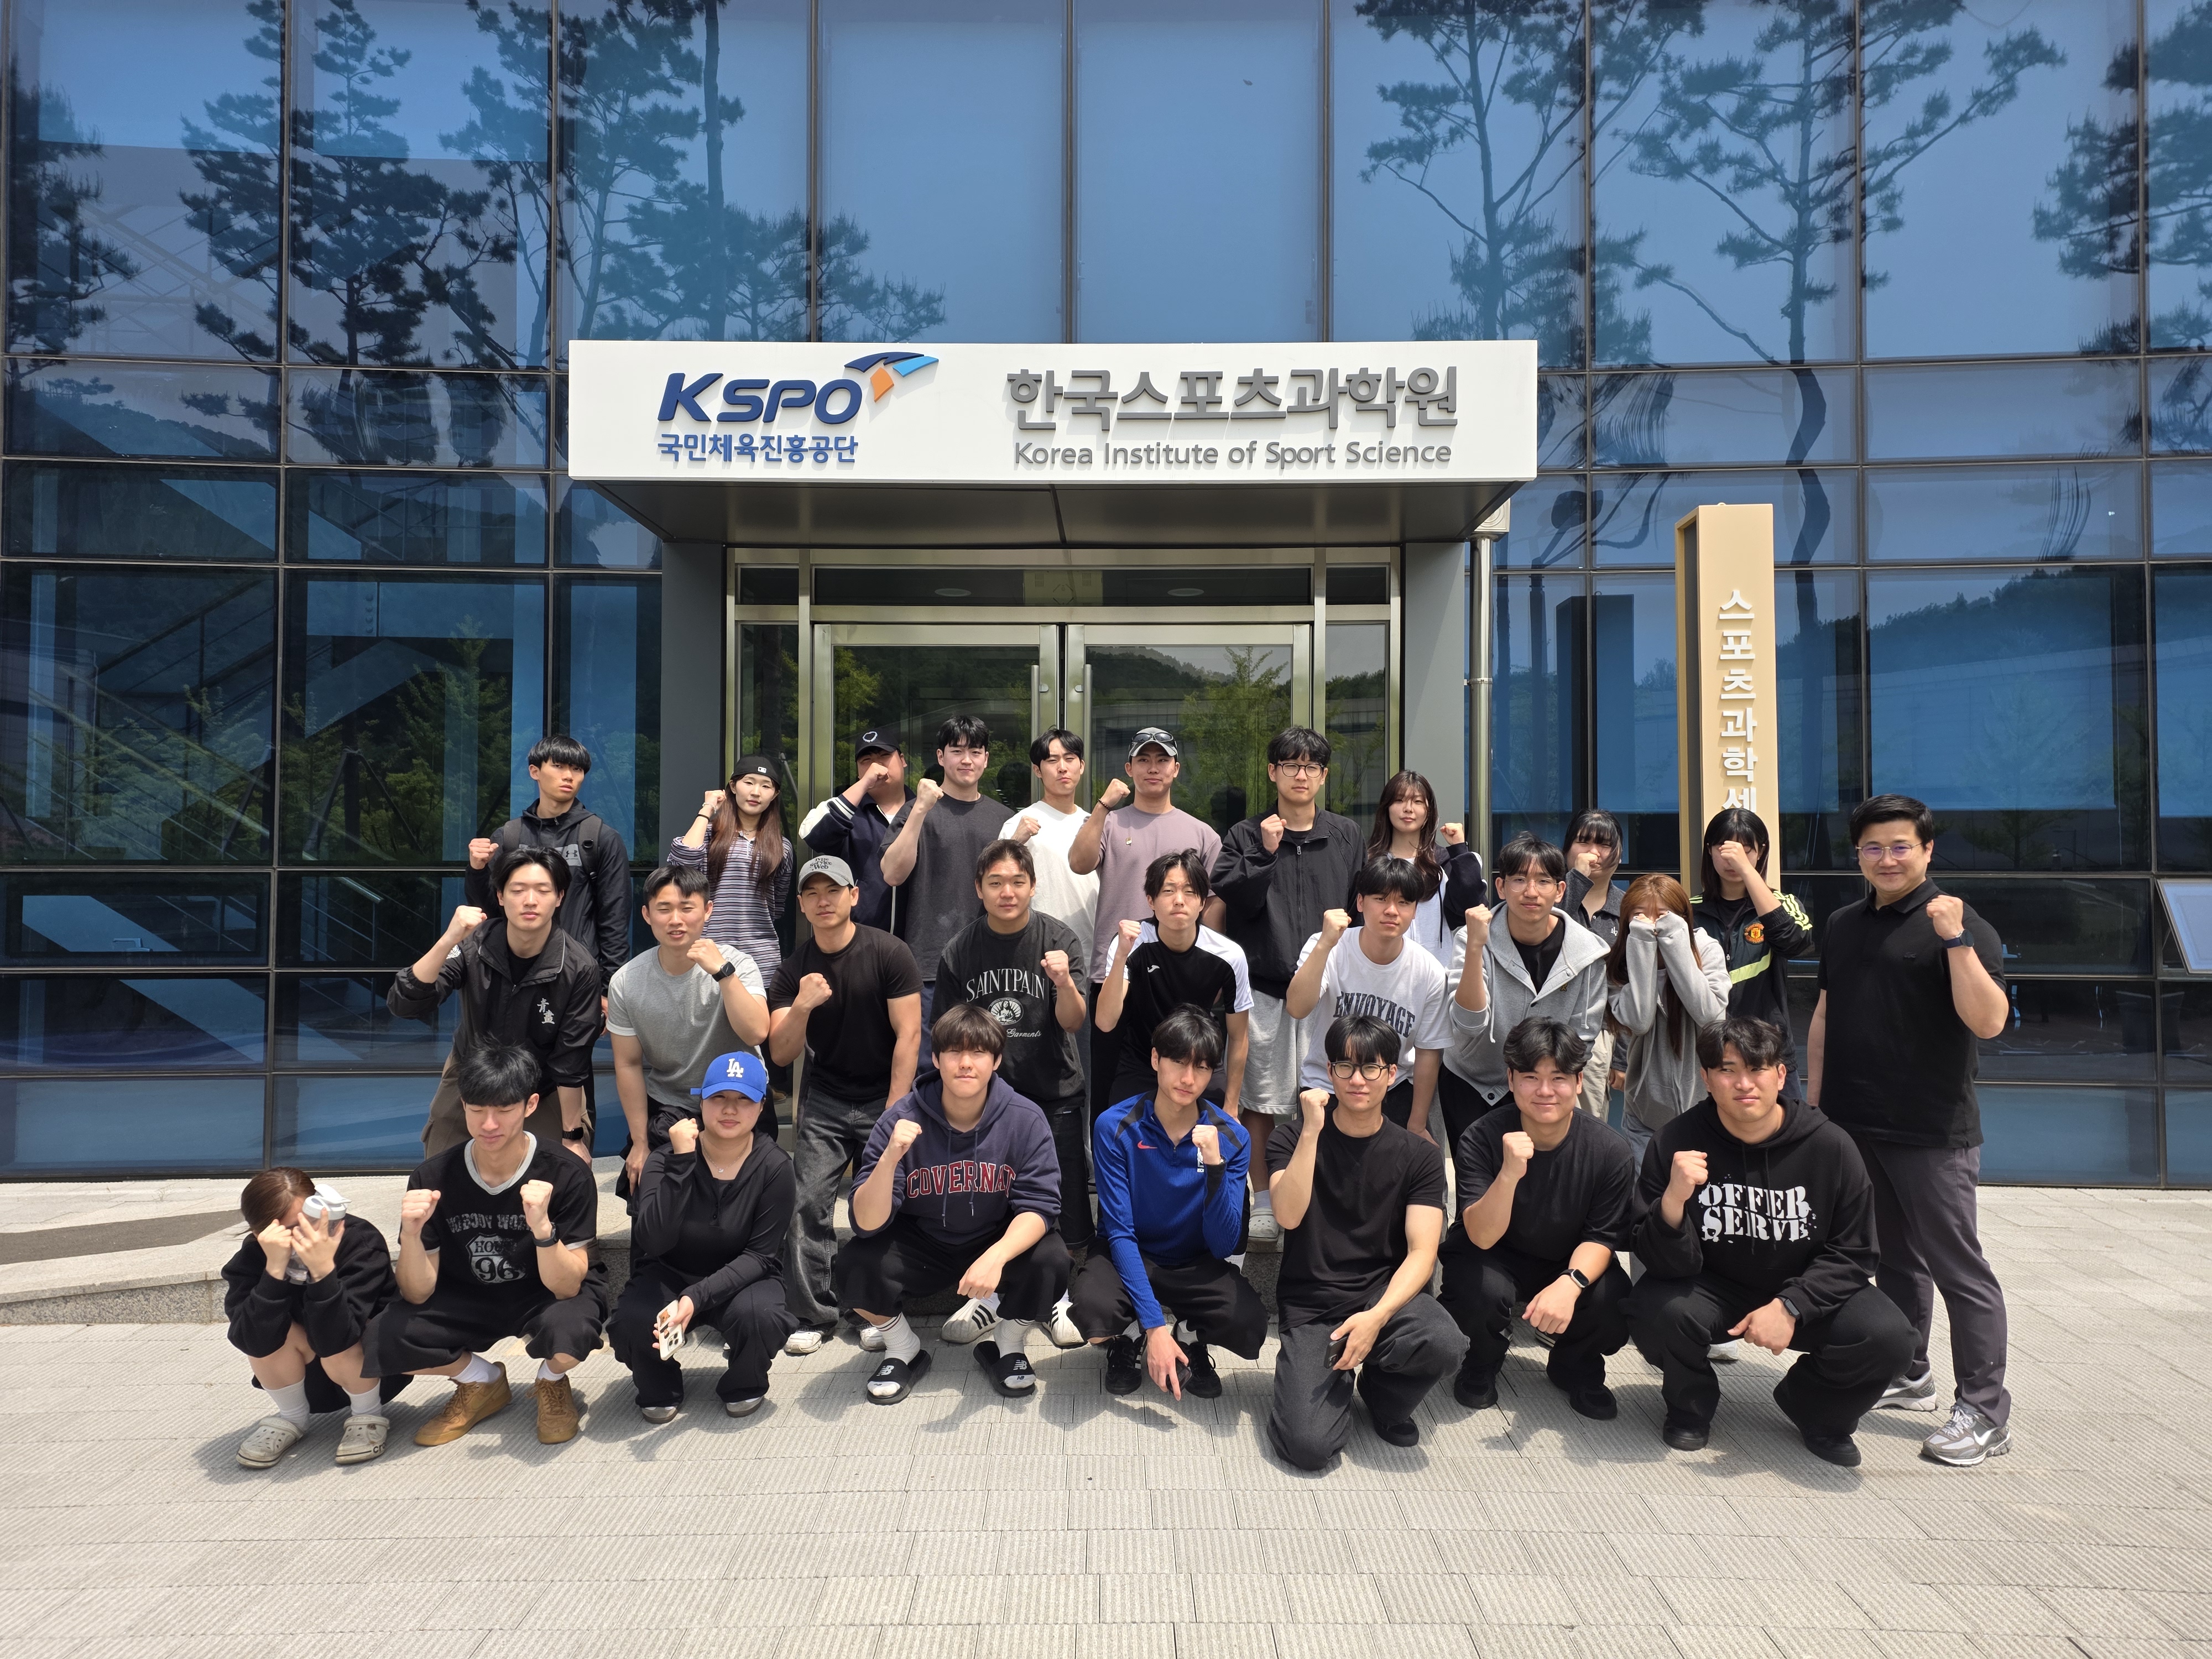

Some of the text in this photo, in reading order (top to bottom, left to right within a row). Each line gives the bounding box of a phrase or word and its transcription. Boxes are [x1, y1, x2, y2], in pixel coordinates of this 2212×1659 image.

[658, 372, 863, 424] KSPO
[1007, 366, 1458, 432] 한국스포츠과학원
[658, 434, 858, 463] 국민체육진흥공단
[1015, 440, 1452, 469] Korea Institute of Sport Science
[1006, 1028, 1042, 1038] Garments
[726, 1058, 744, 1078] LA
[906, 1159, 1016, 1198] COVERNAT
[1698, 1182, 1812, 1219] OFFER
[1701, 1205, 1809, 1243] SERVE
[474, 1256, 520, 1282] 96
